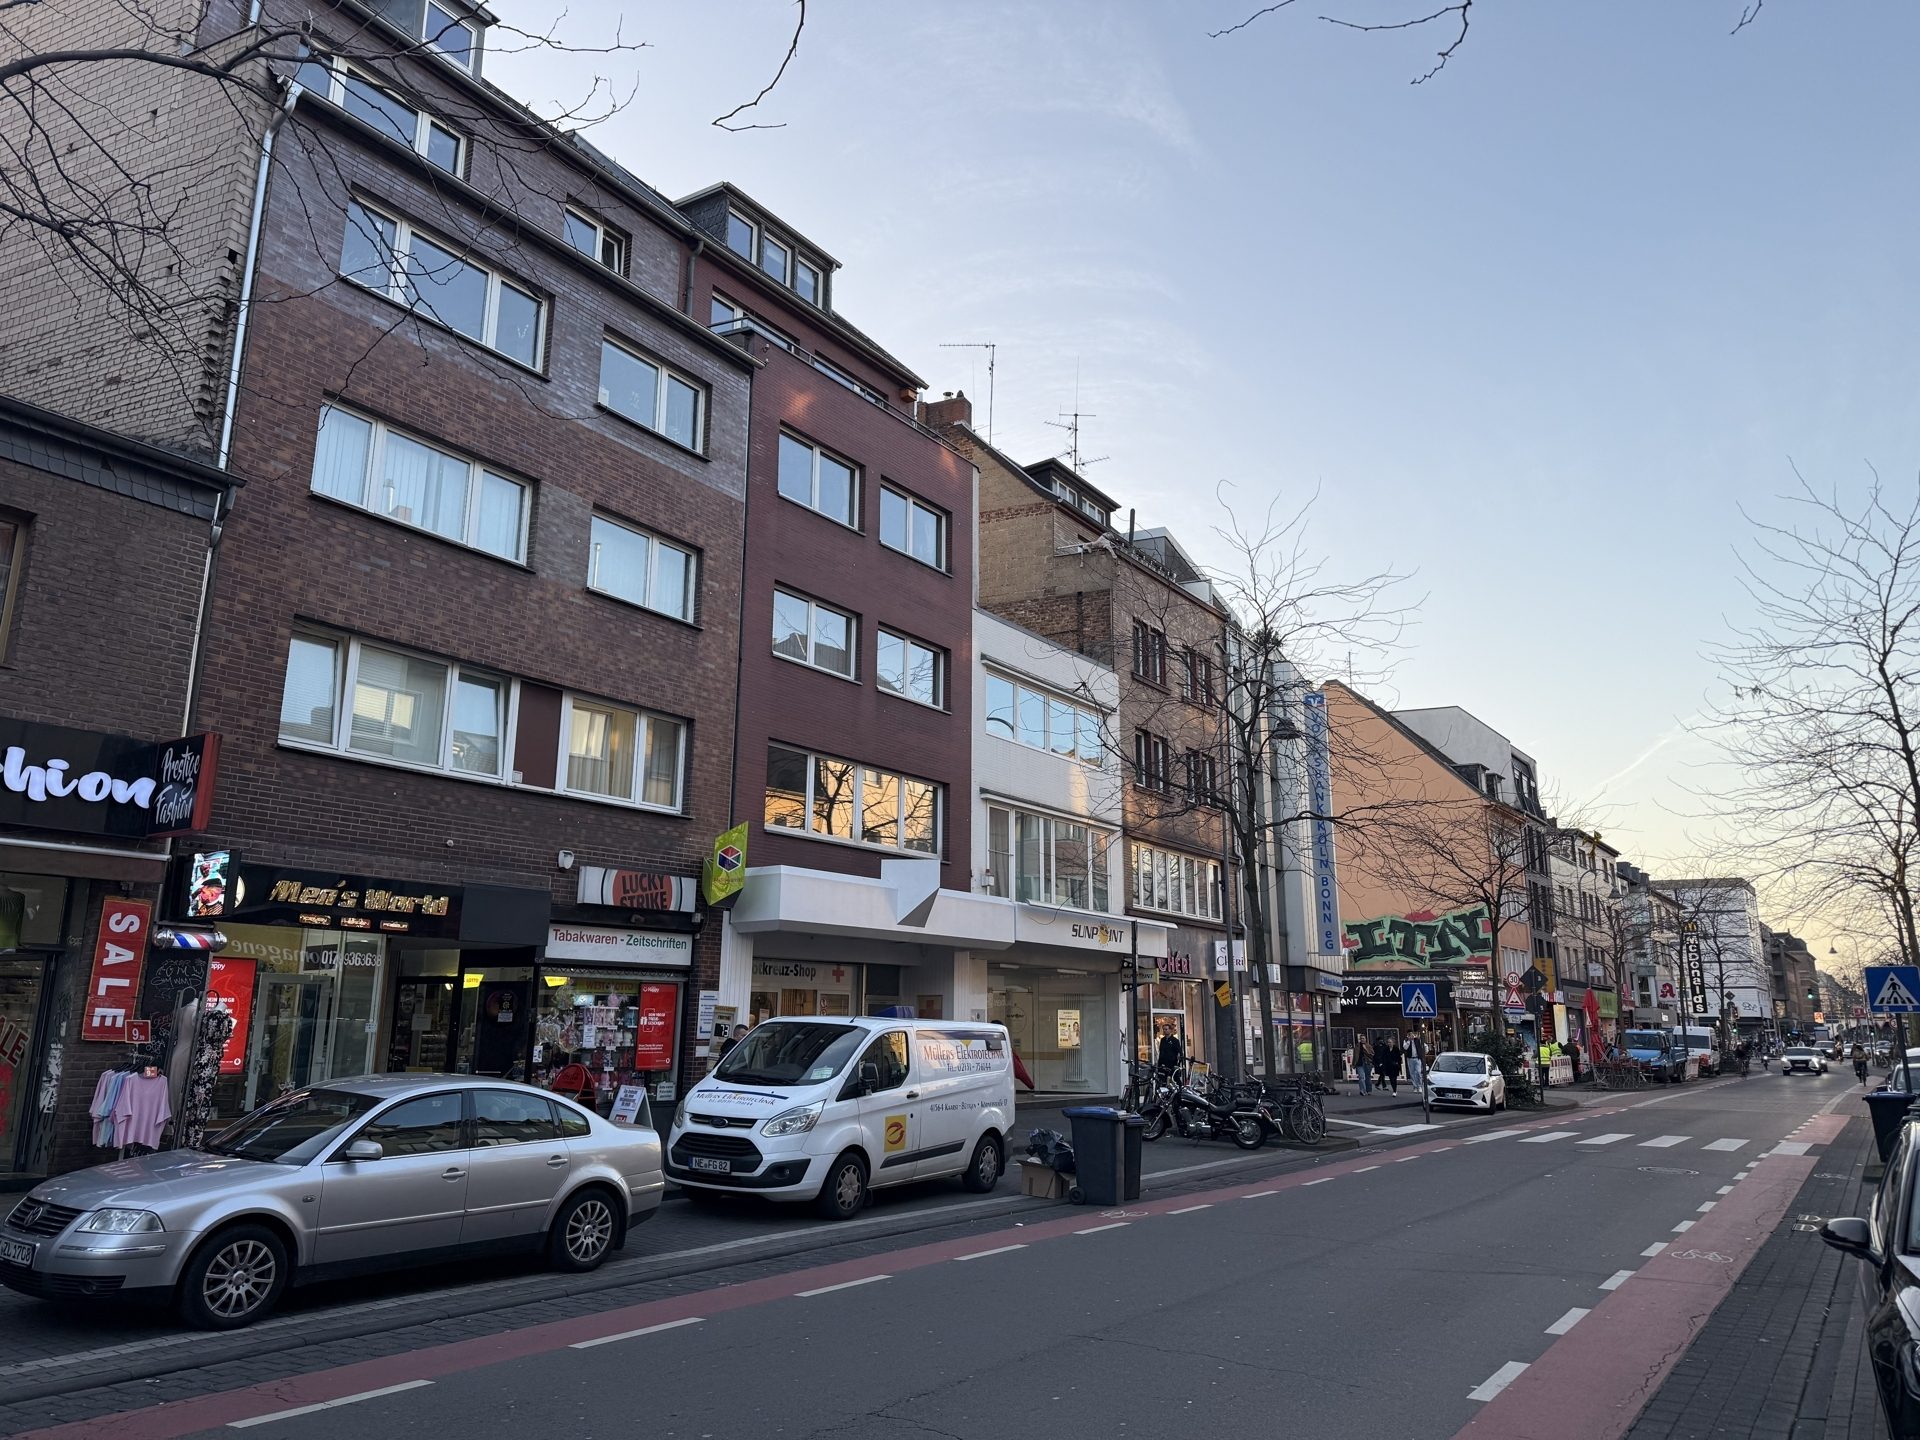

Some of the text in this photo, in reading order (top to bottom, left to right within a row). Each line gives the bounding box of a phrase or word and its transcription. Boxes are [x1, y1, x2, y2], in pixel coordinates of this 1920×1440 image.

[161, 748, 200, 797] Prestige
[1311, 712, 1325, 814] VOSBANK
[0, 746, 156, 809] hion
[154, 785, 193, 825] Fashion
[621, 873, 664, 894] LUCKY
[269, 880, 449, 916] Men's World
[620, 891, 668, 910] STRIKE
[1321, 877, 1331, 923] BONN
[553, 929, 618, 945] Tabakwaren
[625, 934, 687, 950] Zeitschriften
[1325, 930, 1334, 950] eG
[211, 963, 226, 971] appy
[321, 950, 382, 967] 0179363638
[92, 911, 140, 1028] SALE
[752, 961, 816, 981] otkreuz-Shop
[1509, 975, 1517, 984] 30
[694, 1158, 728, 1171] NE FG 82
